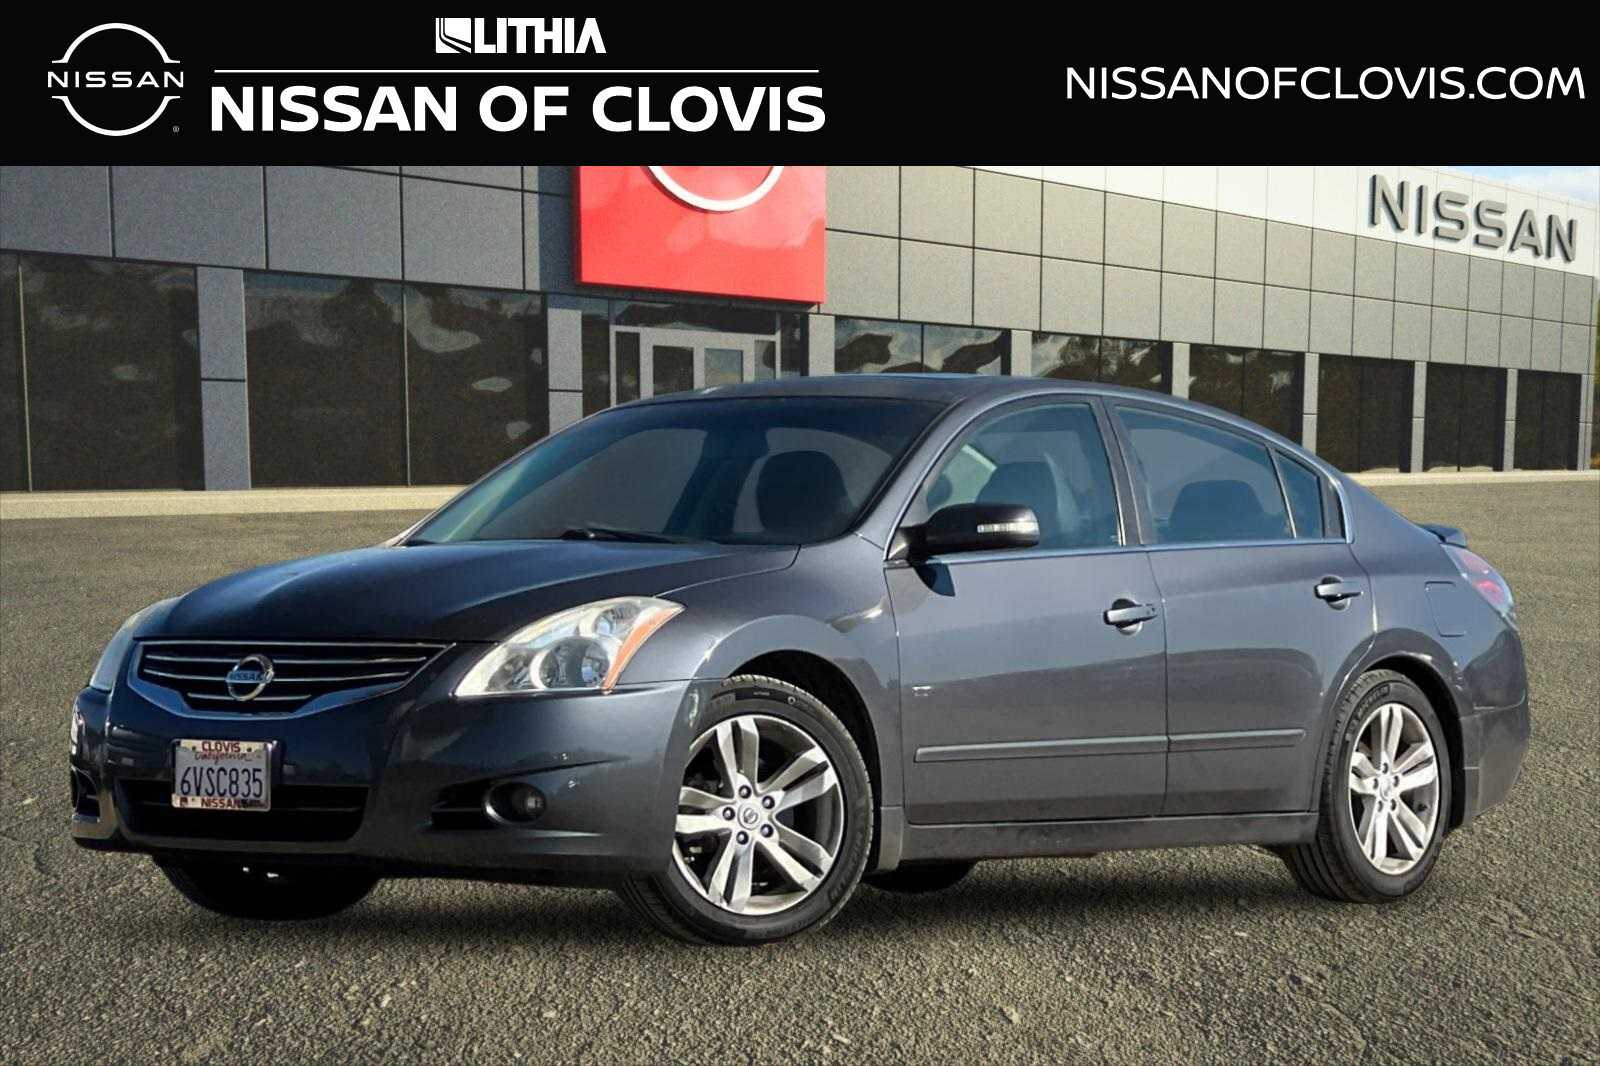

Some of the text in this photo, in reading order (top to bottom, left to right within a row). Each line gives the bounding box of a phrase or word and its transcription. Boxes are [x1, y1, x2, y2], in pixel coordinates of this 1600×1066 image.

[1368, 174, 1577, 263] NISSAN
[201, 741, 241, 753] CLOVIS
[180, 766, 263, 798] 6VSC835
[201, 797, 240, 809] NISSAN
